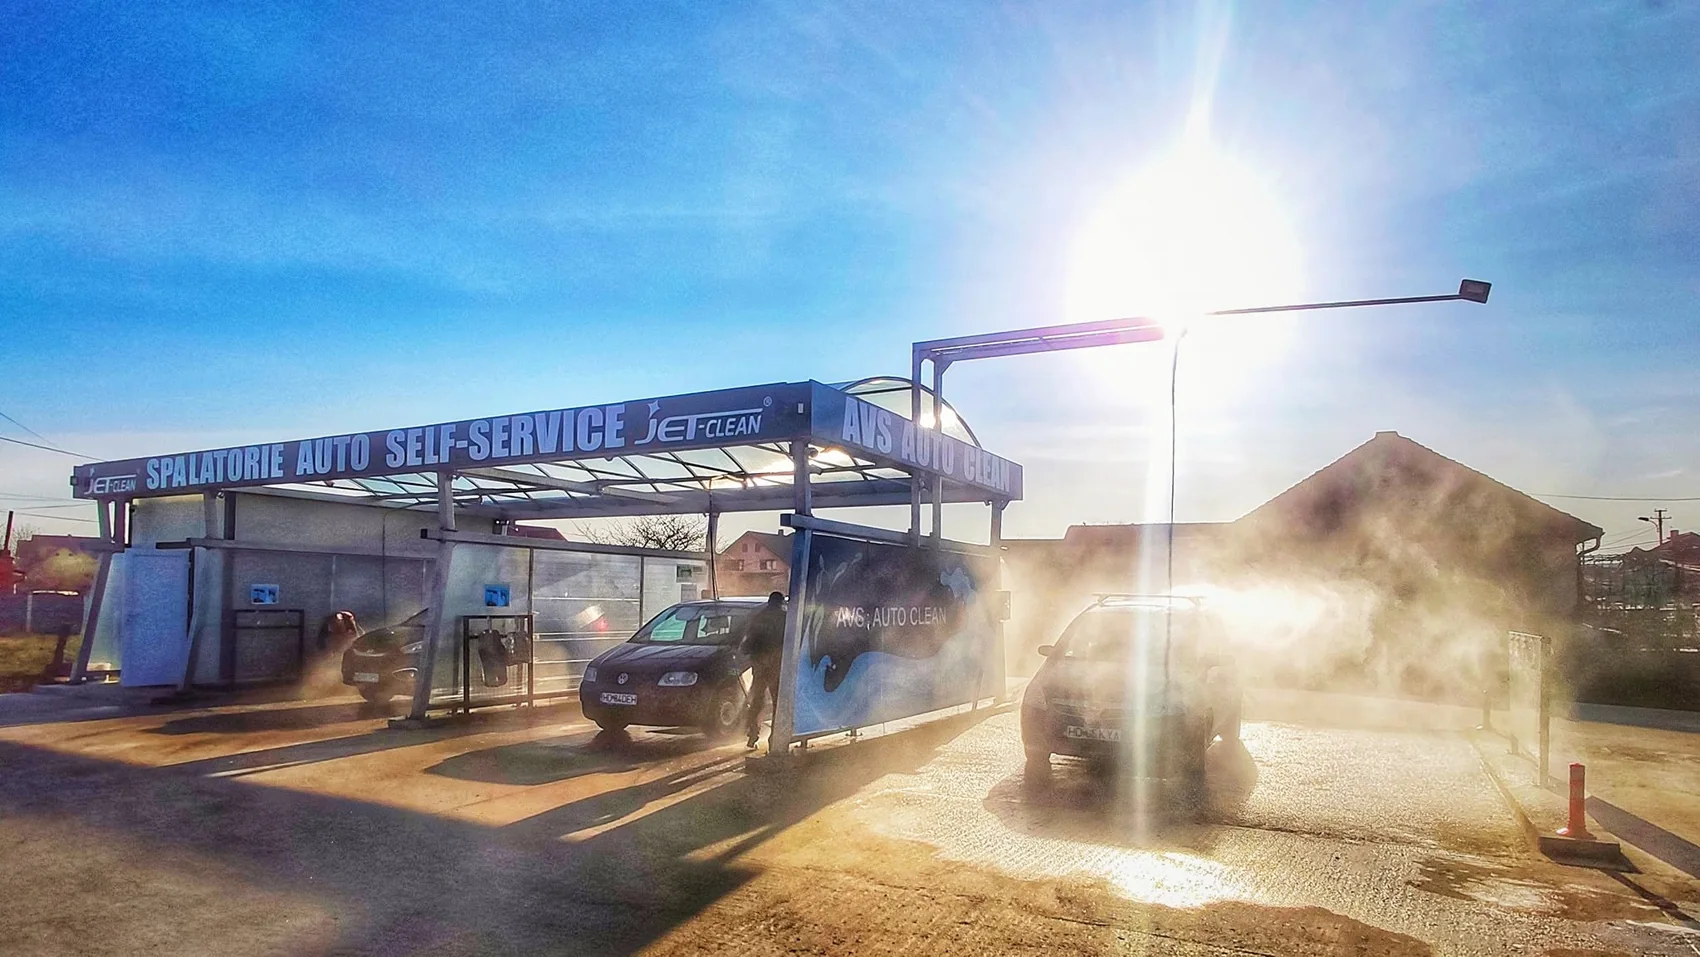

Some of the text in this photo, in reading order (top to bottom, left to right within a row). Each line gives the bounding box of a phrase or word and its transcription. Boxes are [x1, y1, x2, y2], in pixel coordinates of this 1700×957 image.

[146, 404, 625, 490] SPALATORIE AUTO SELF-SERVICE
[842, 397, 1010, 492] AVS AUTO CLEAN
[872, 606, 907, 627] AUTO
[909, 606, 947, 626] CLEAN
